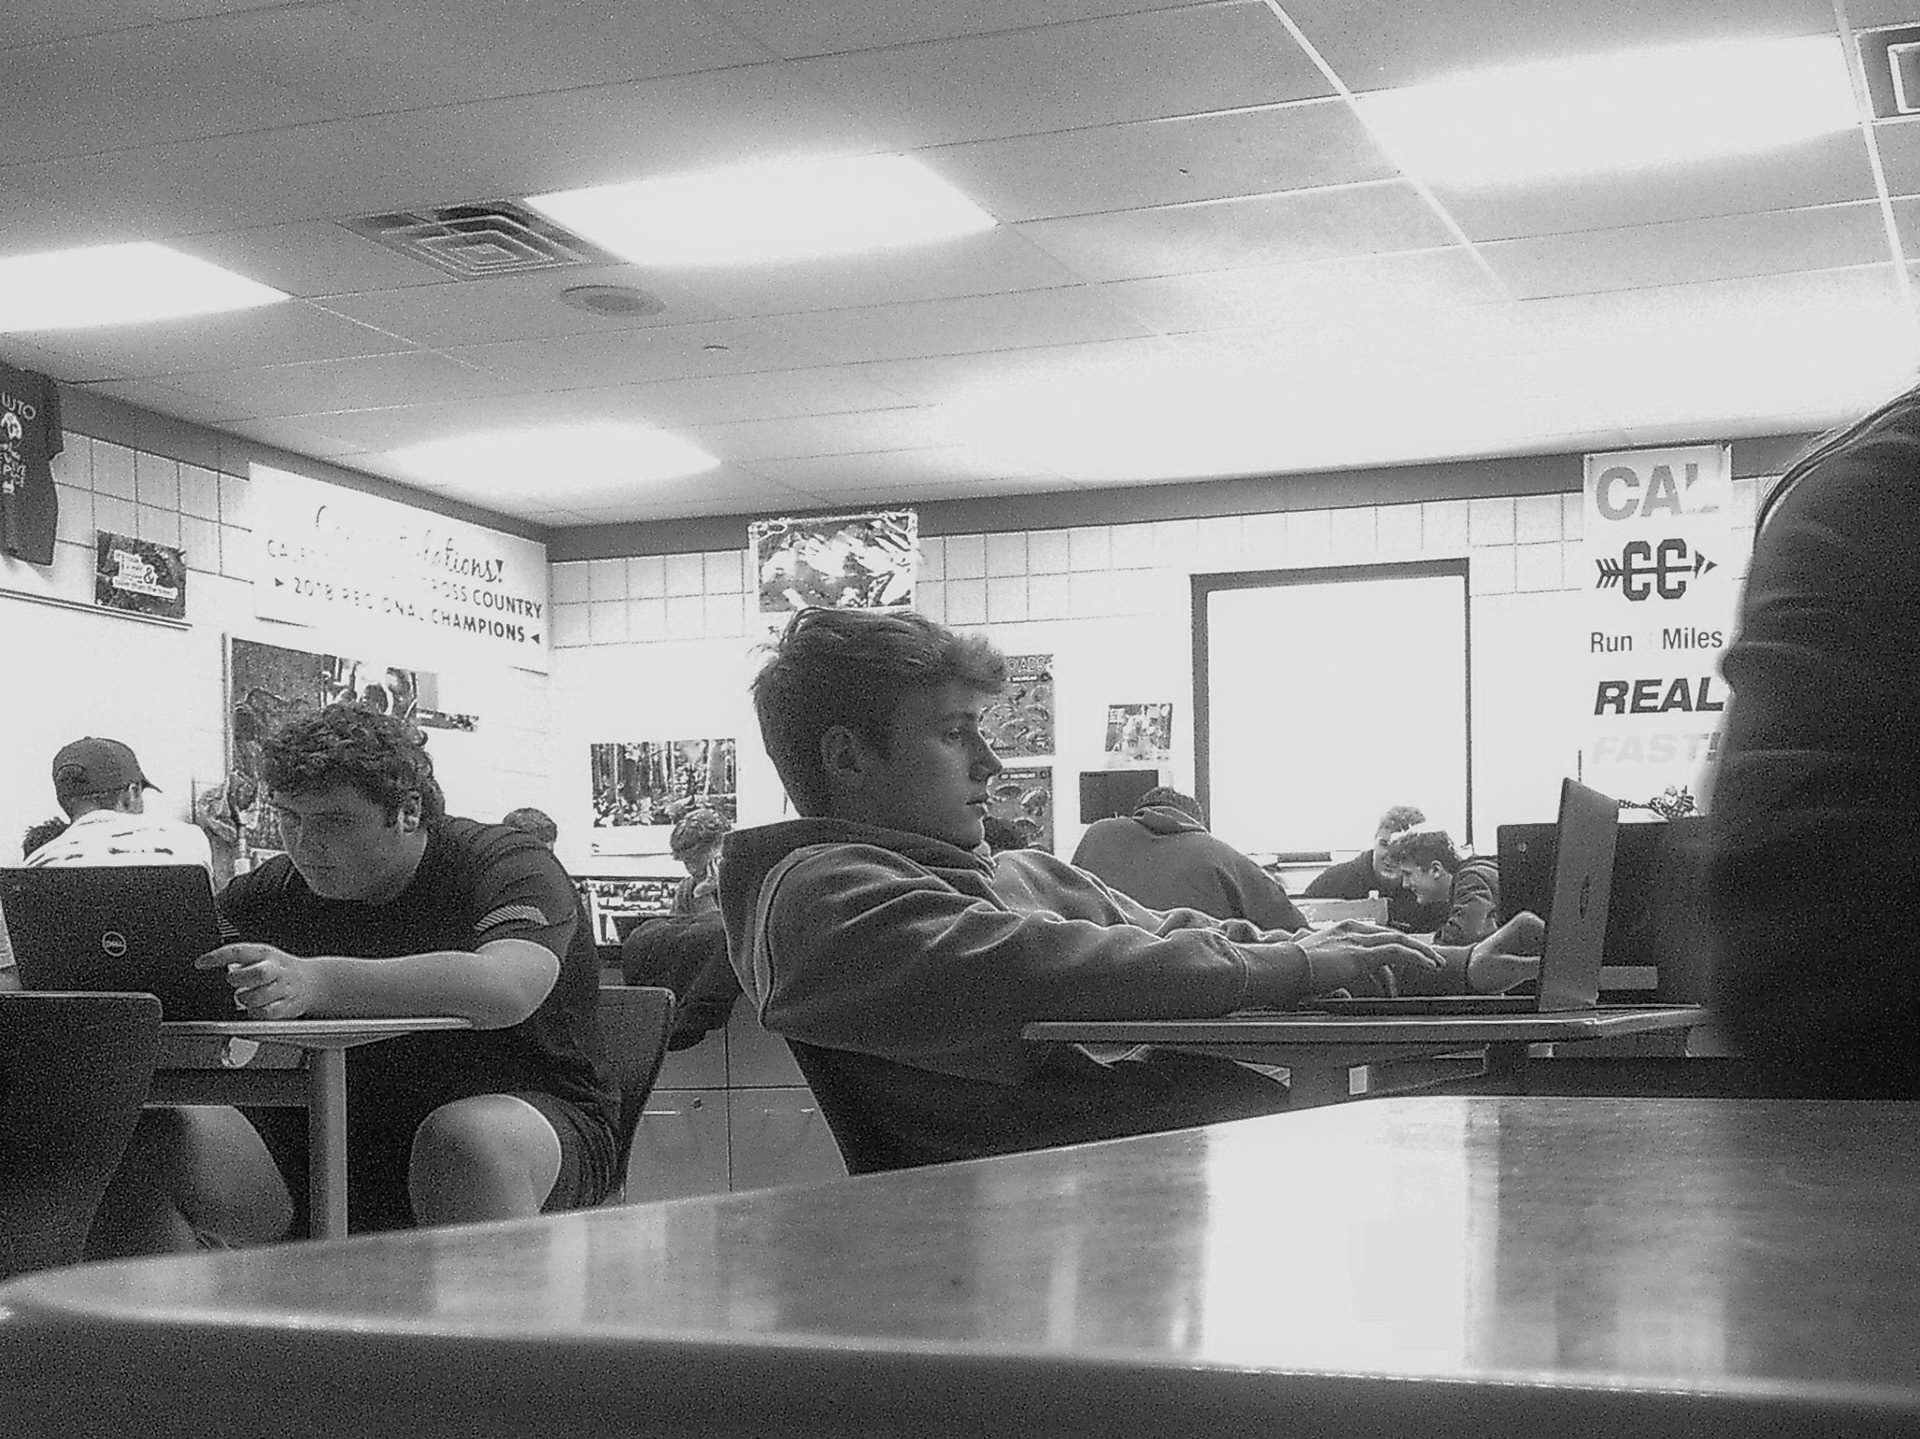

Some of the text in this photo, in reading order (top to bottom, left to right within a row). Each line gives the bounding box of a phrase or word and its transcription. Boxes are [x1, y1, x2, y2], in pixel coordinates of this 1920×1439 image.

[1596, 462, 1719, 521] CAL
[342, 588, 424, 621] REGONAL
[432, 608, 526, 643] CHAMPIONS
[423, 577, 542, 620] ROSS COUNTRY
[1590, 631, 1634, 654] Run
[1662, 627, 1724, 651] Miles
[1593, 676, 1725, 716] REAL
